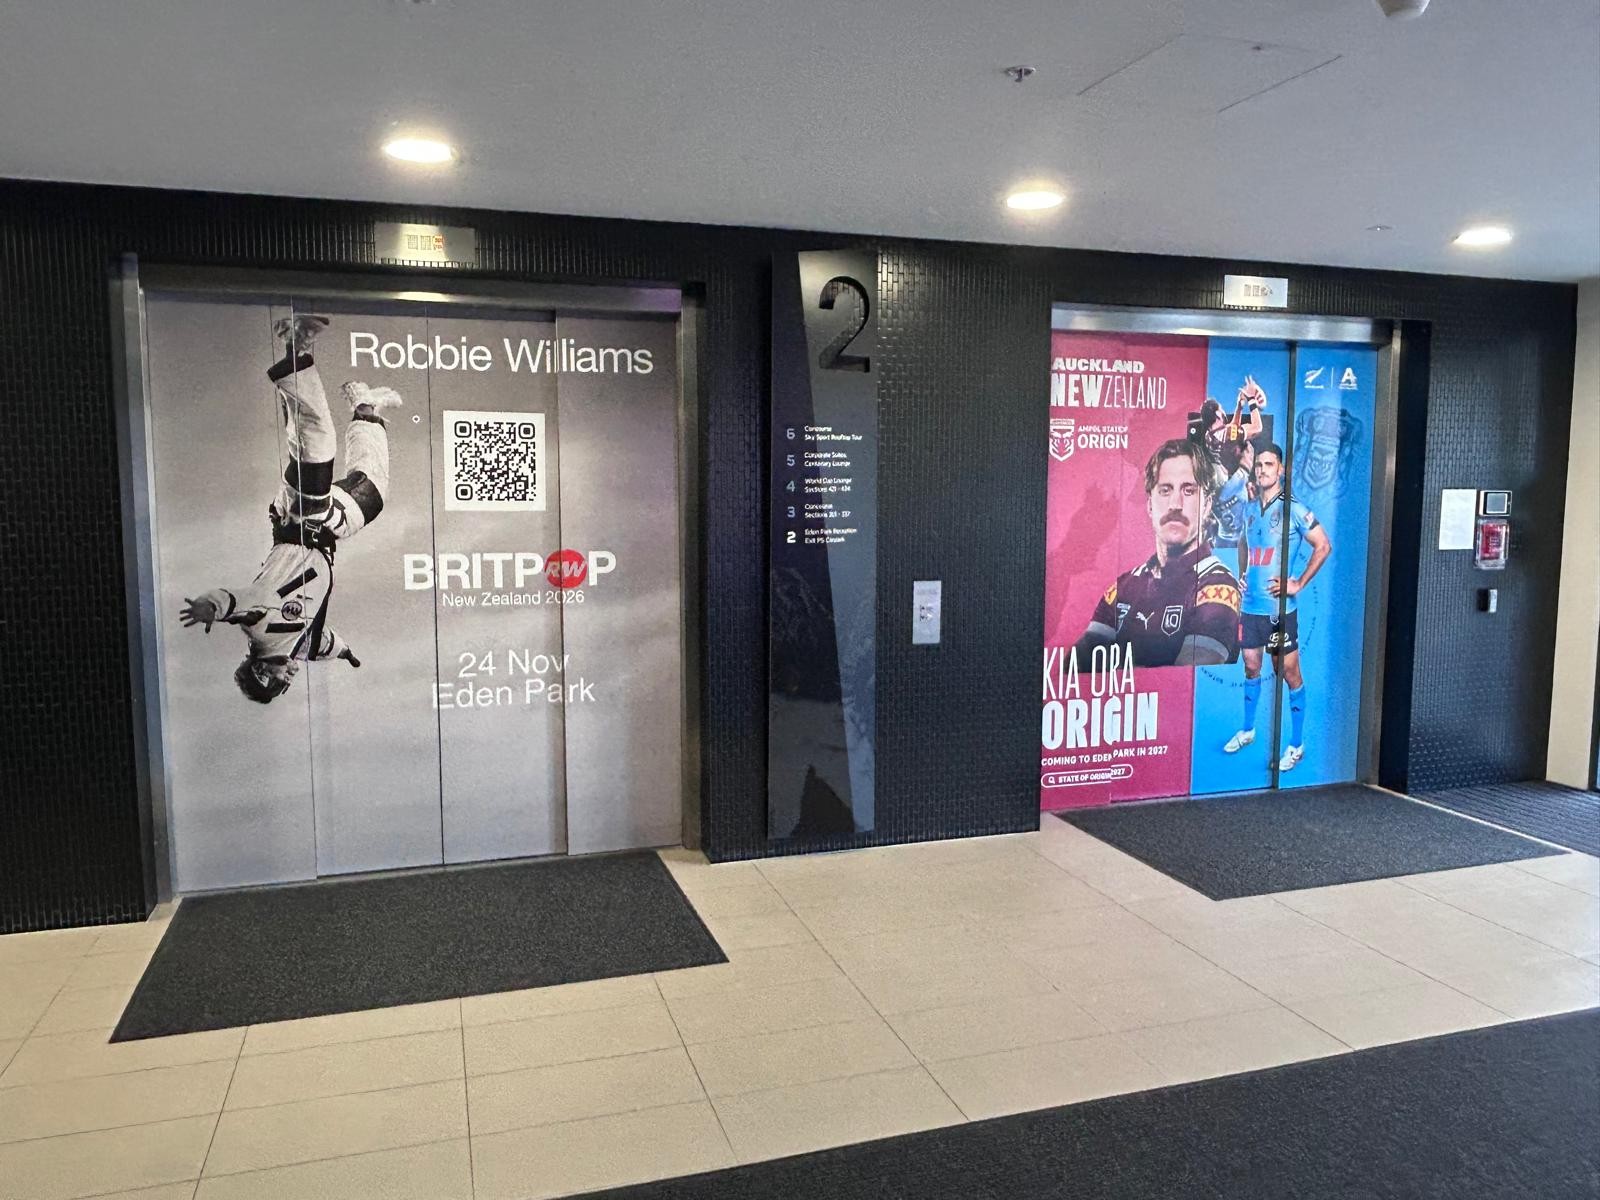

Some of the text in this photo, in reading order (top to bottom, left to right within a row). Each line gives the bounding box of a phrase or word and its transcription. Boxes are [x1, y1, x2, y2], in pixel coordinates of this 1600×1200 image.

[818, 275, 870, 373] 2
[350, 332, 655, 375] Robbie Williams
[1052, 357, 1145, 373] AUCKLAND
[786, 428, 796, 440] 6
[1077, 434, 1129, 449] ORIGIN
[786, 454, 796, 467] 5
[786, 480, 796, 492] 4
[787, 505, 796, 518] 3
[786, 531, 796, 544] 2
[442, 590, 585, 608] New Zealand 2026
[458, 649, 570, 678] 24 Nov
[1042, 641, 1135, 700] KIA ORA
[432, 677, 596, 710] Eden Park
[1041, 691, 1159, 750] ORIGIN
[1041, 755, 1077, 767] COMING
[1079, 754, 1090, 764] TO
[1113, 747, 1135, 759] PARK
[1137, 747, 1146, 756] IN
[1147, 745, 1169, 756] 2027
[1058, 773, 1079, 784] STATE
[1080, 772, 1089, 783] OF
